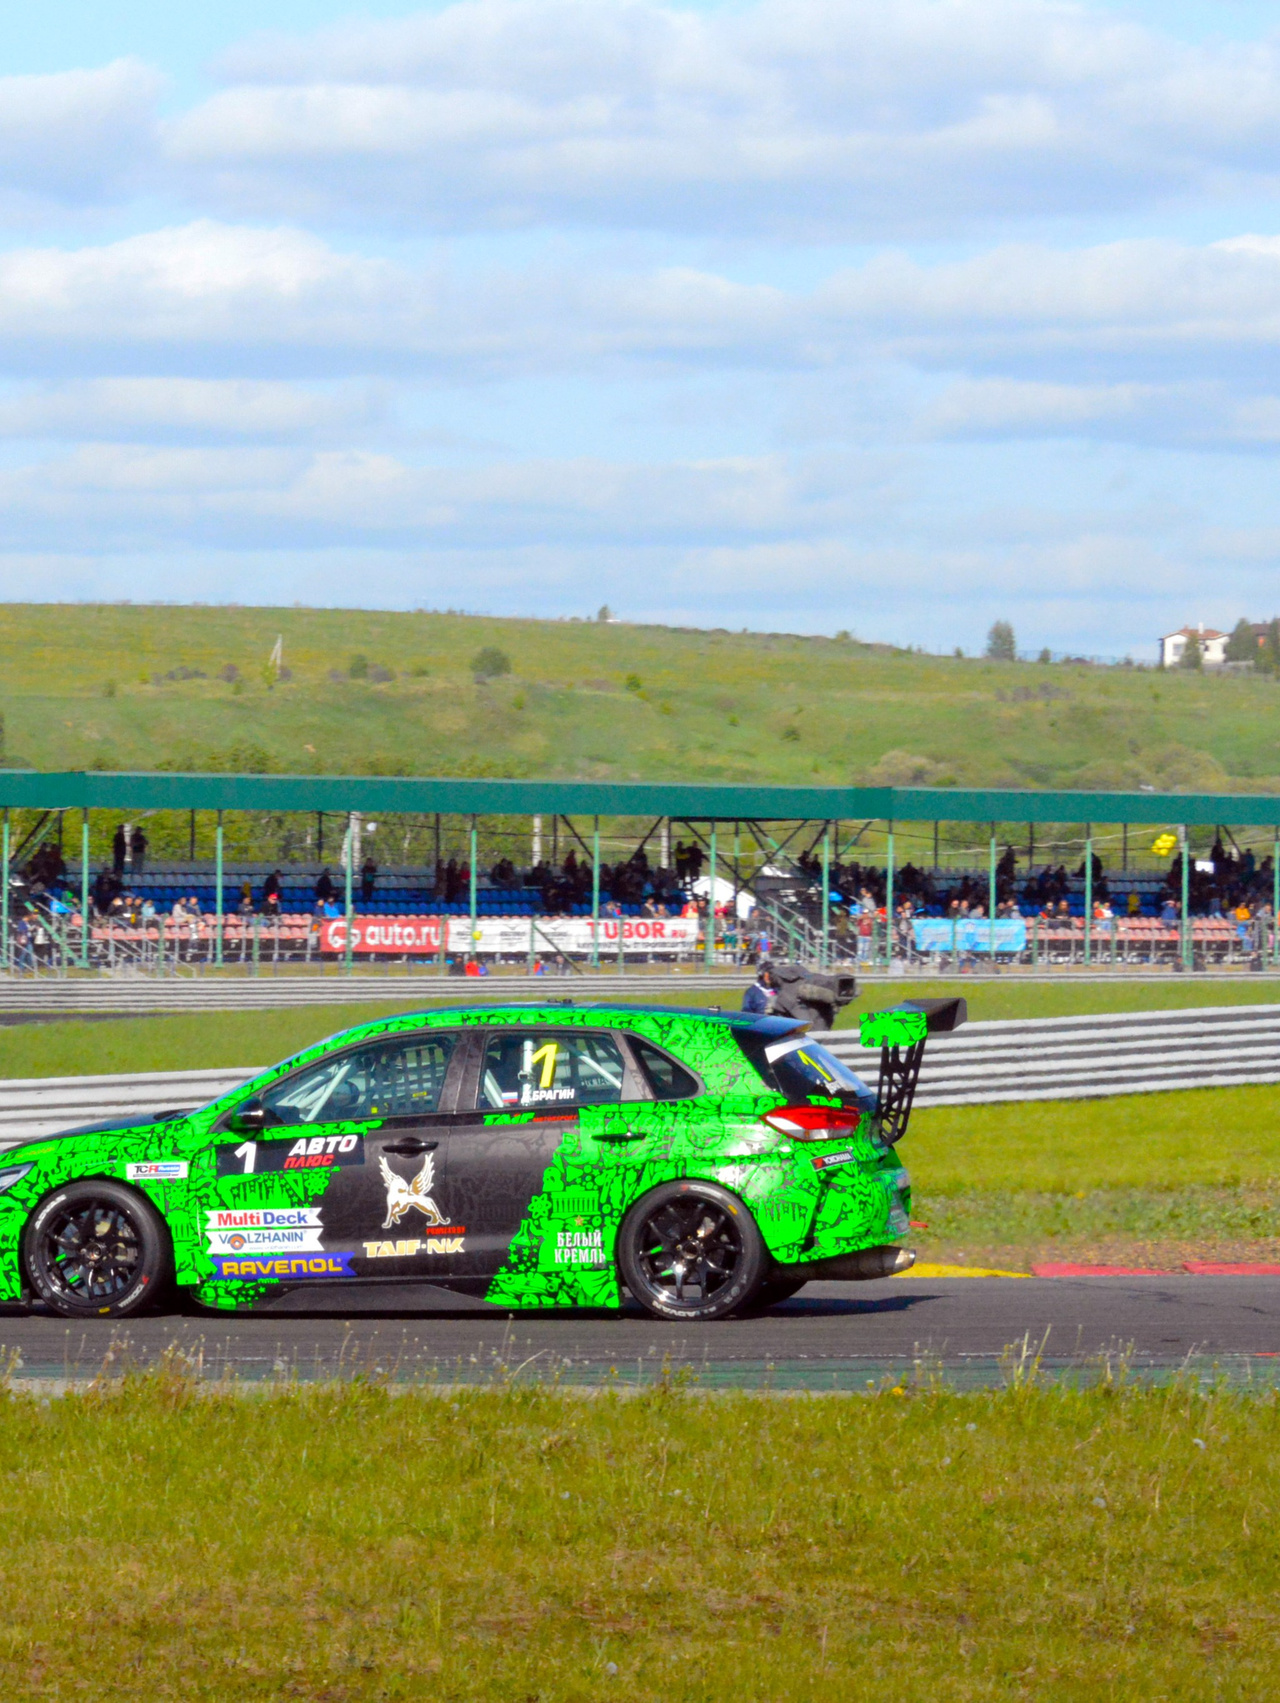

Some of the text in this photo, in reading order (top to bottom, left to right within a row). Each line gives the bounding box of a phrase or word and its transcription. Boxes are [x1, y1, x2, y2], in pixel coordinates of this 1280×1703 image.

[366, 923, 442, 946] auto.ru
[586, 921, 666, 940] TUBOR
[530, 1043, 558, 1088] 1
[797, 1049, 832, 1082] 1
[483, 1111, 536, 1126] TAIF
[288, 1134, 358, 1156] АВТО
[234, 1141, 257, 1174] 1
[283, 1154, 335, 1169] ПЛЮС
[217, 1211, 308, 1226] Multi Deck
[557, 1229, 602, 1247] БЕЛЫЙ
[554, 1248, 606, 1264] КРЕМЛЬ
[222, 1258, 342, 1276] RAVENOL
